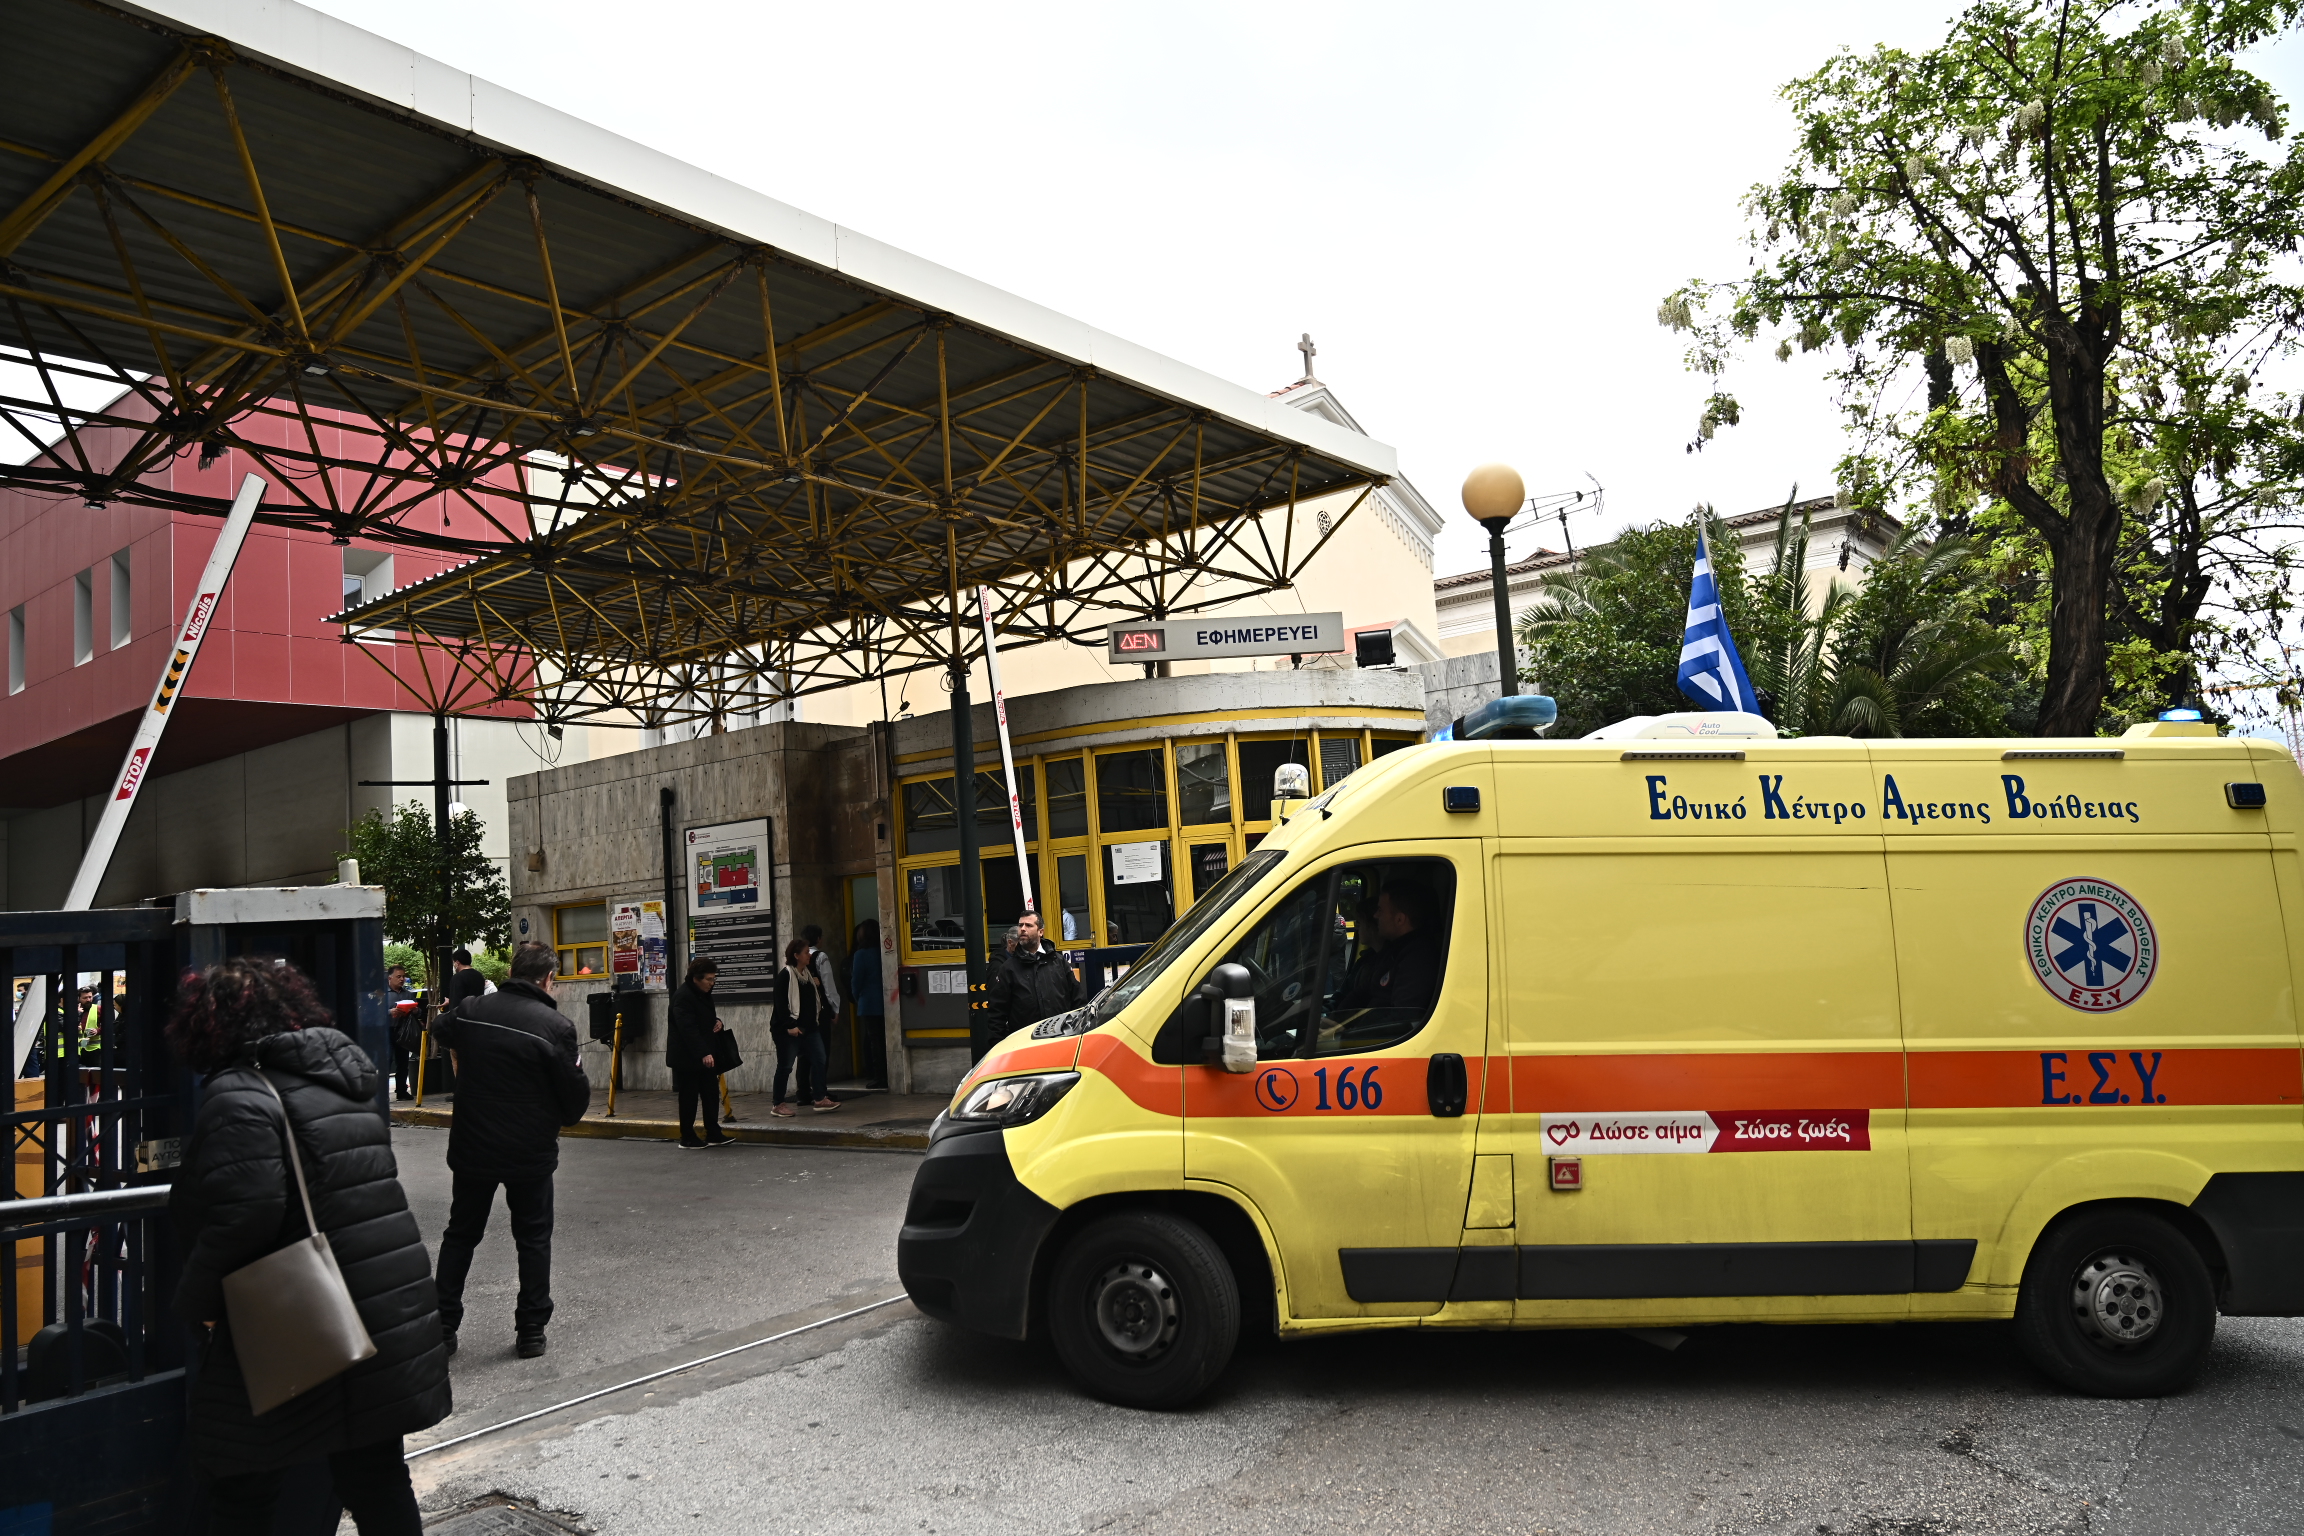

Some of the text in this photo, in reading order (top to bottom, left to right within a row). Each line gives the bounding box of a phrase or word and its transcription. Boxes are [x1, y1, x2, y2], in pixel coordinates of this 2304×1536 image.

[187, 596, 212, 639] Nicolis
[1120, 633, 1159, 650] ΔΕΝ
[1196, 625, 1318, 646] ΕΦΗΜΕΡΕΥΕΙ
[122, 755, 143, 792] STOP
[1012, 800, 1021, 823] STOP
[1645, 773, 2140, 826] Εθνικό Κέντρο Αμεσης Βοήθειας
[2032, 884, 2151, 979] ΕΘΝΙΚΟ ΚΕΝΤΡΟ ΑΜΕΣΗΣ ΒΟΗΘΕΙΑΣ
[2068, 988, 2122, 1007] Ε.Σ.Υ
[1313, 1065, 1383, 1111] 166
[2040, 1052, 2167, 1104] Ε.Σ.Υ.
[1589, 1121, 1702, 1144] Δώσε αίμα
[1734, 1118, 1851, 1143] Σώσε ζωές
